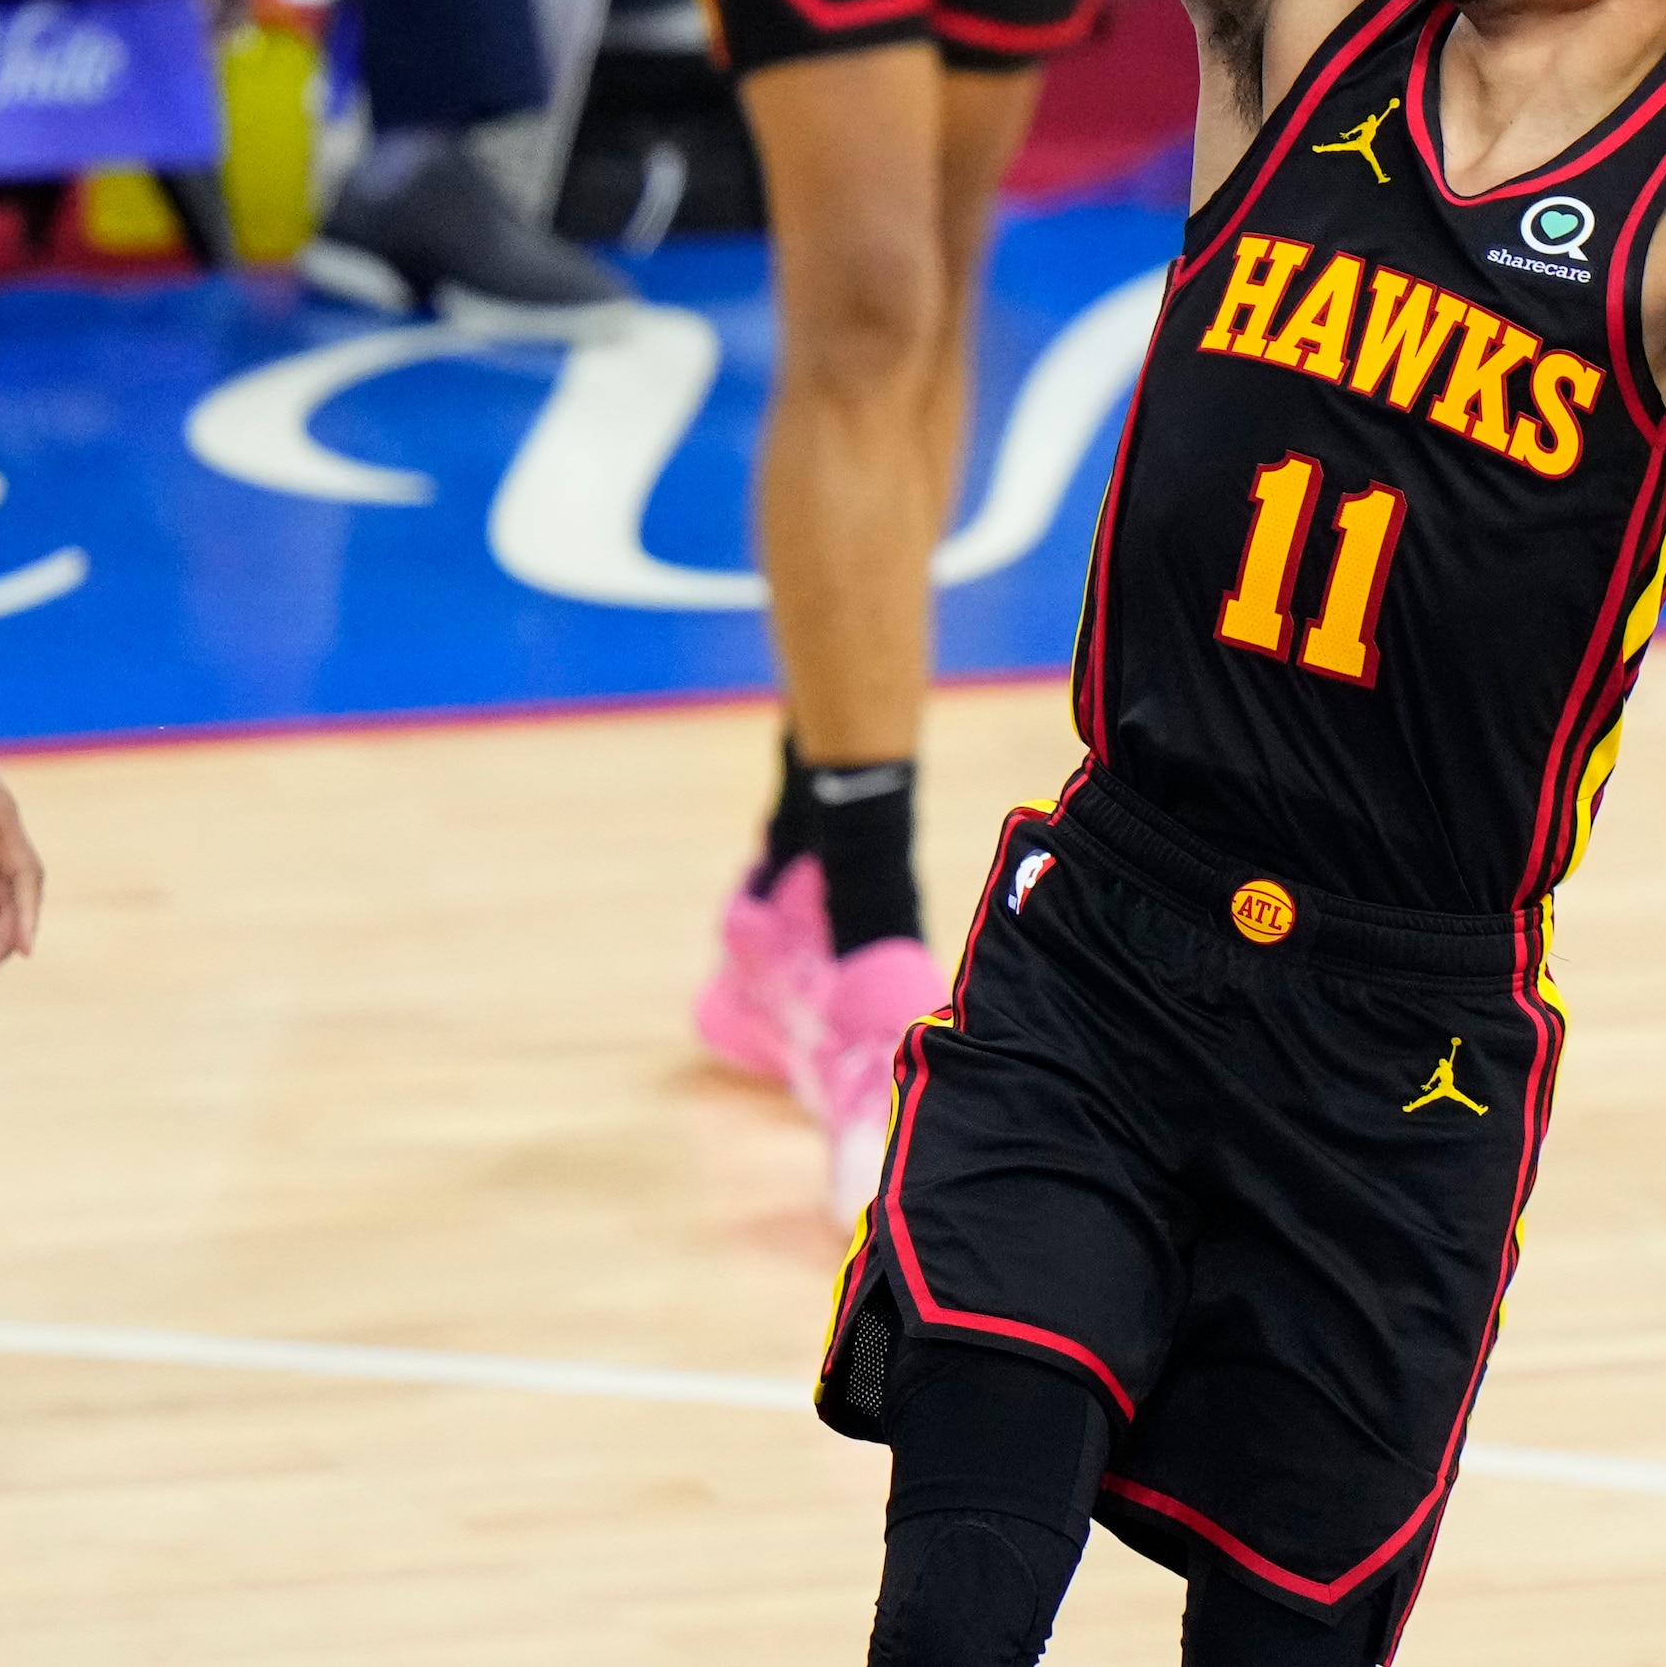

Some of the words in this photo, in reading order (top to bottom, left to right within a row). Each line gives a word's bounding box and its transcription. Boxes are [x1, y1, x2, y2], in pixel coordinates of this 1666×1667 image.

[1486, 248, 1592, 284] sharecare
[1198, 231, 1607, 479] HAWKS
[1213, 449, 1408, 689] 11
[1237, 894, 1282, 931] ATL
